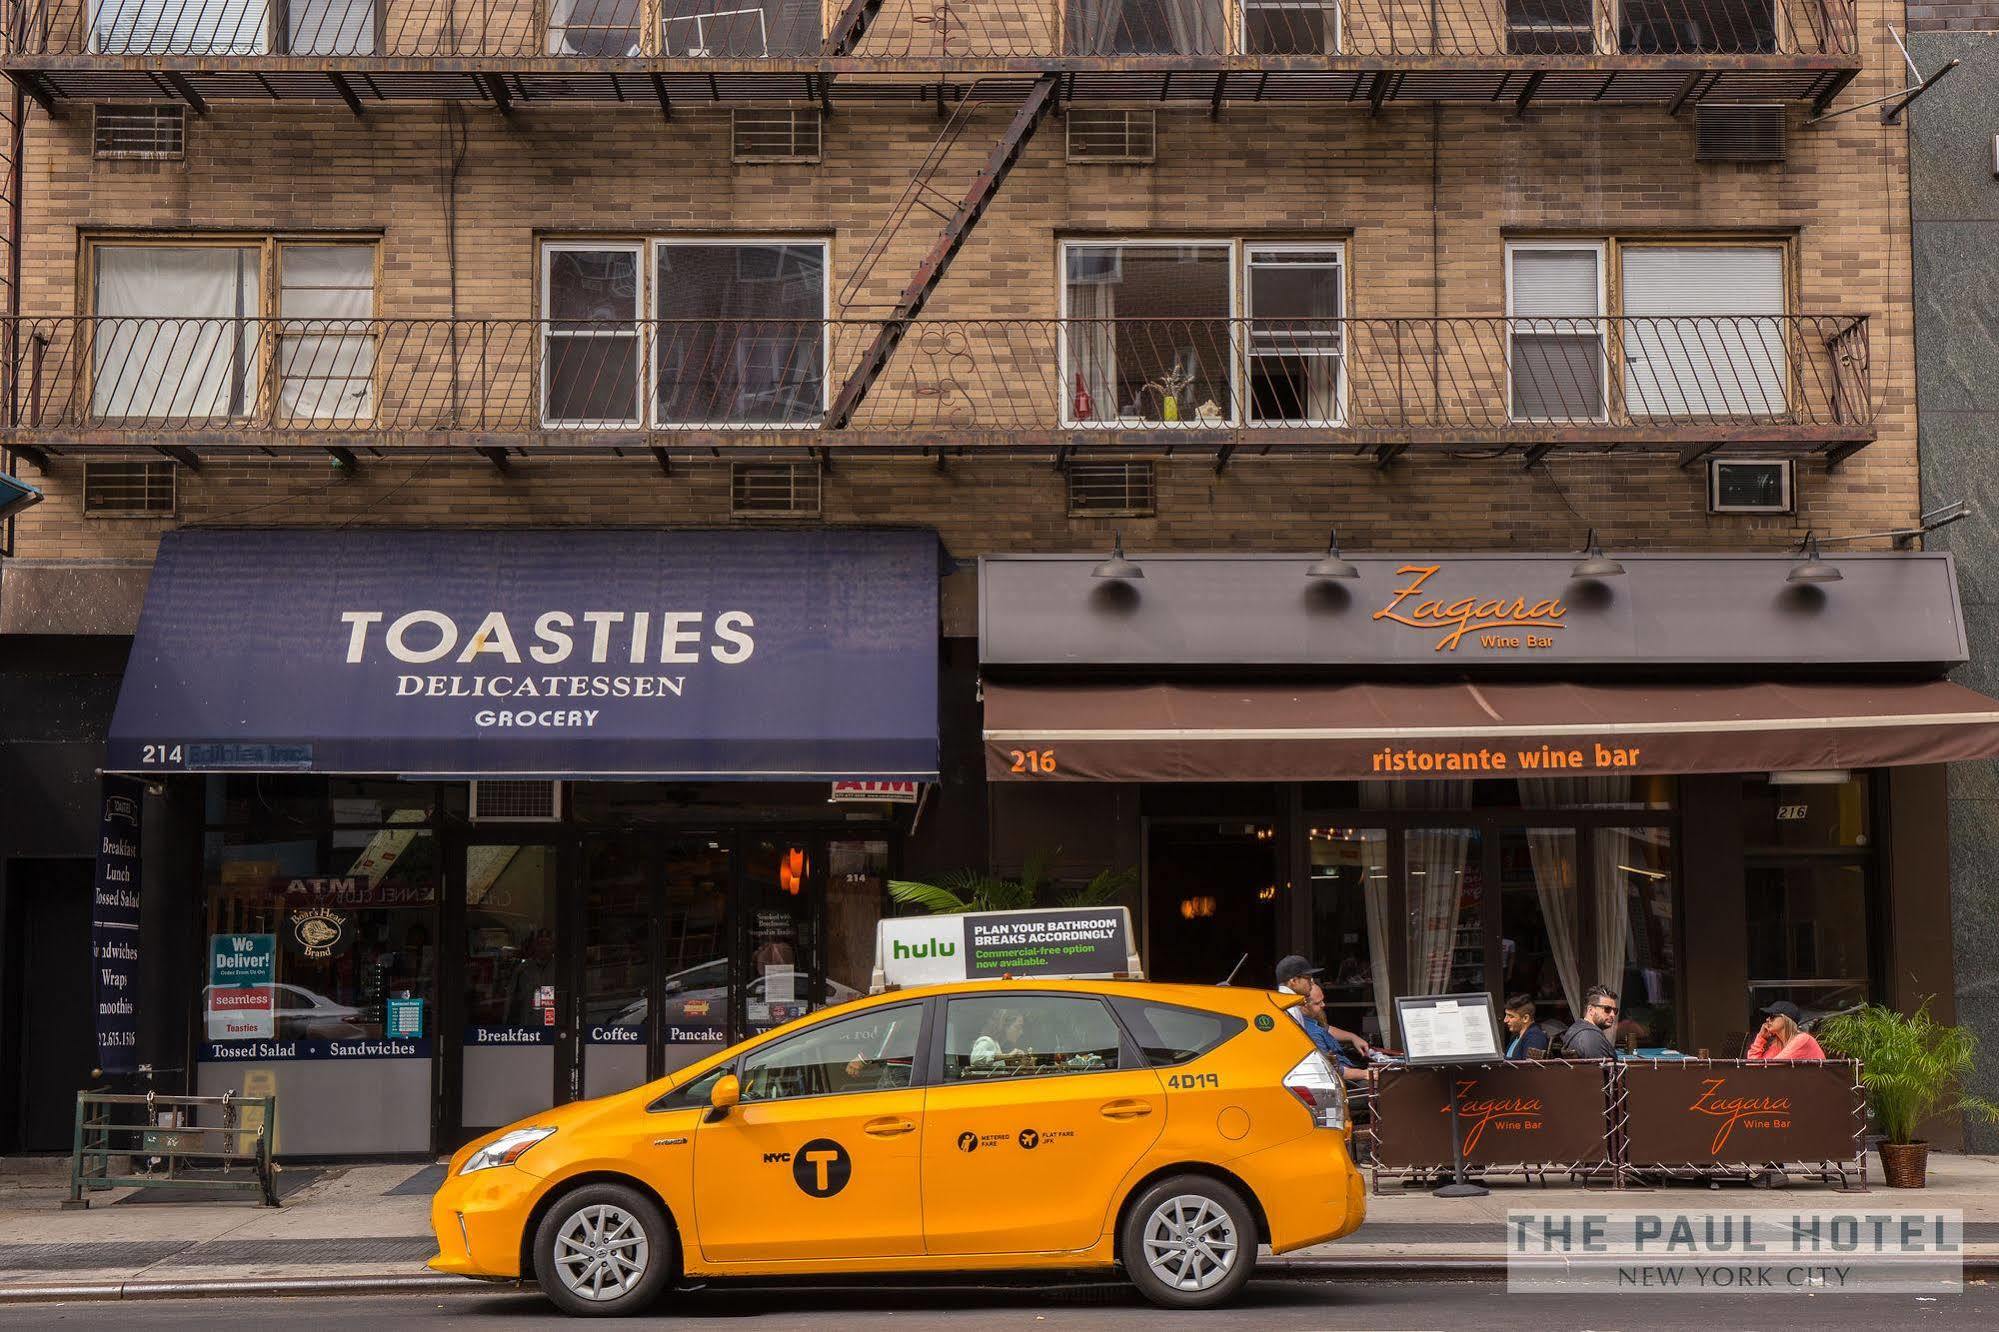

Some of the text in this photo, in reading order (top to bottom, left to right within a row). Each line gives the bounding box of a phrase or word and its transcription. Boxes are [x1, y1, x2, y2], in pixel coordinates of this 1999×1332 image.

[1372, 564, 1567, 651] Zagara
[340, 609, 755, 665] TOASTIES
[1480, 634, 1554, 649] Wine Bar
[395, 674, 687, 698] DELICATESSEN
[474, 709, 601, 728] GROCERY
[142, 744, 183, 764] 214
[1010, 750, 1057, 773] 216
[1373, 743, 1640, 771] ristorante wine bar
[1779, 806, 1806, 819] 216
[102, 836, 137, 858] Breakfast
[105, 863, 131, 882] Lunch
[847, 874, 866, 882] 214
[286, 878, 356, 894] ATM
[120, 889, 140, 909] Salad
[320, 907, 346, 925] Head
[974, 918, 1117, 936] PLAN YOUR BATHROOM
[232, 937, 254, 952] We
[974, 928, 1116, 946] BREAKS ACCORDINGLY
[304, 946, 332, 957] Brand
[893, 937, 956, 960] hulu
[975, 944, 1096, 959] Commercial-free option
[216, 953, 270, 968] Deliver!
[976, 956, 1049, 969] now available.
[216, 994, 268, 1005] seamless
[226, 1024, 258, 1033] Toasties
[477, 1028, 541, 1042] Breakfast
[592, 1027, 638, 1041] Coffee
[670, 1027, 724, 1041] Pancake
[212, 1041, 415, 1058] Tossed Salad Sandwiches
[1168, 1073, 1219, 1089] 4D19
[1495, 1120, 1543, 1130] Wine Bar
[1689, 1079, 1792, 1155] Zagara
[1744, 1119, 1791, 1129] Wine Bar
[763, 1150, 838, 1191] NYC T
